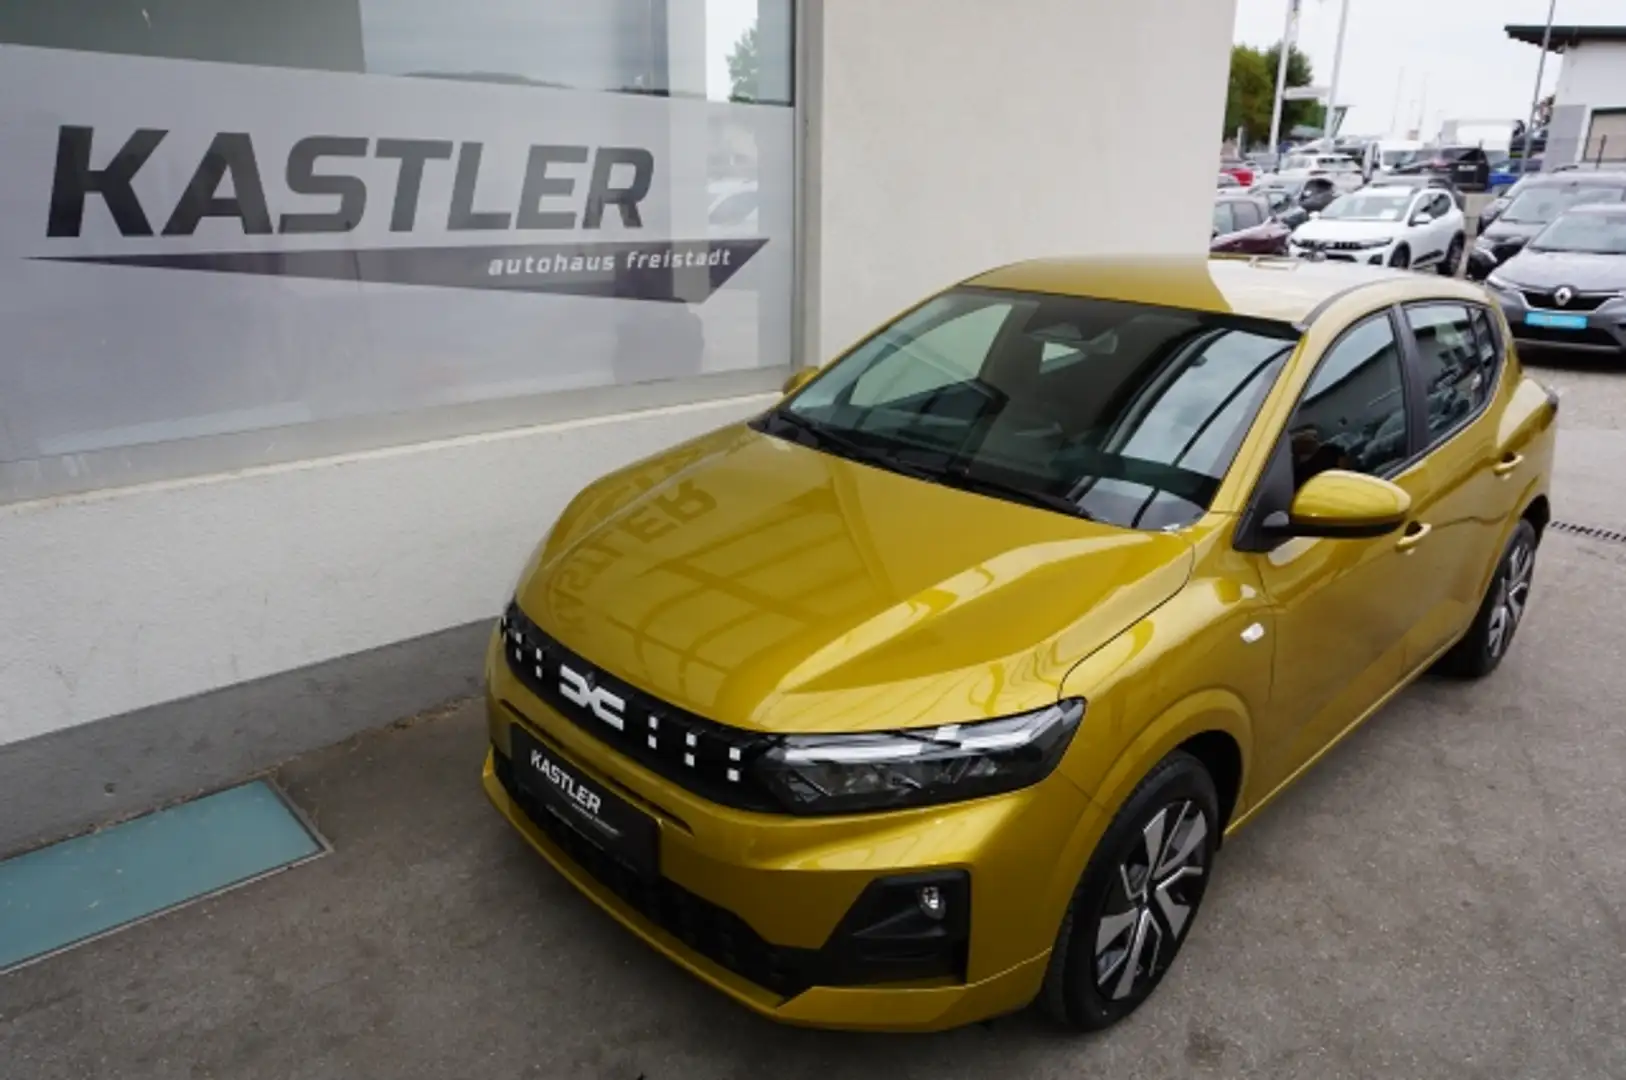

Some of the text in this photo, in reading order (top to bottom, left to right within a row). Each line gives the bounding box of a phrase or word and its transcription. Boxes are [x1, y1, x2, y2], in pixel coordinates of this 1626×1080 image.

[46, 125, 653, 237] KASTLER
[488, 249, 731, 276] autohaus freistadt
[531, 749, 601, 814] KASTLER
